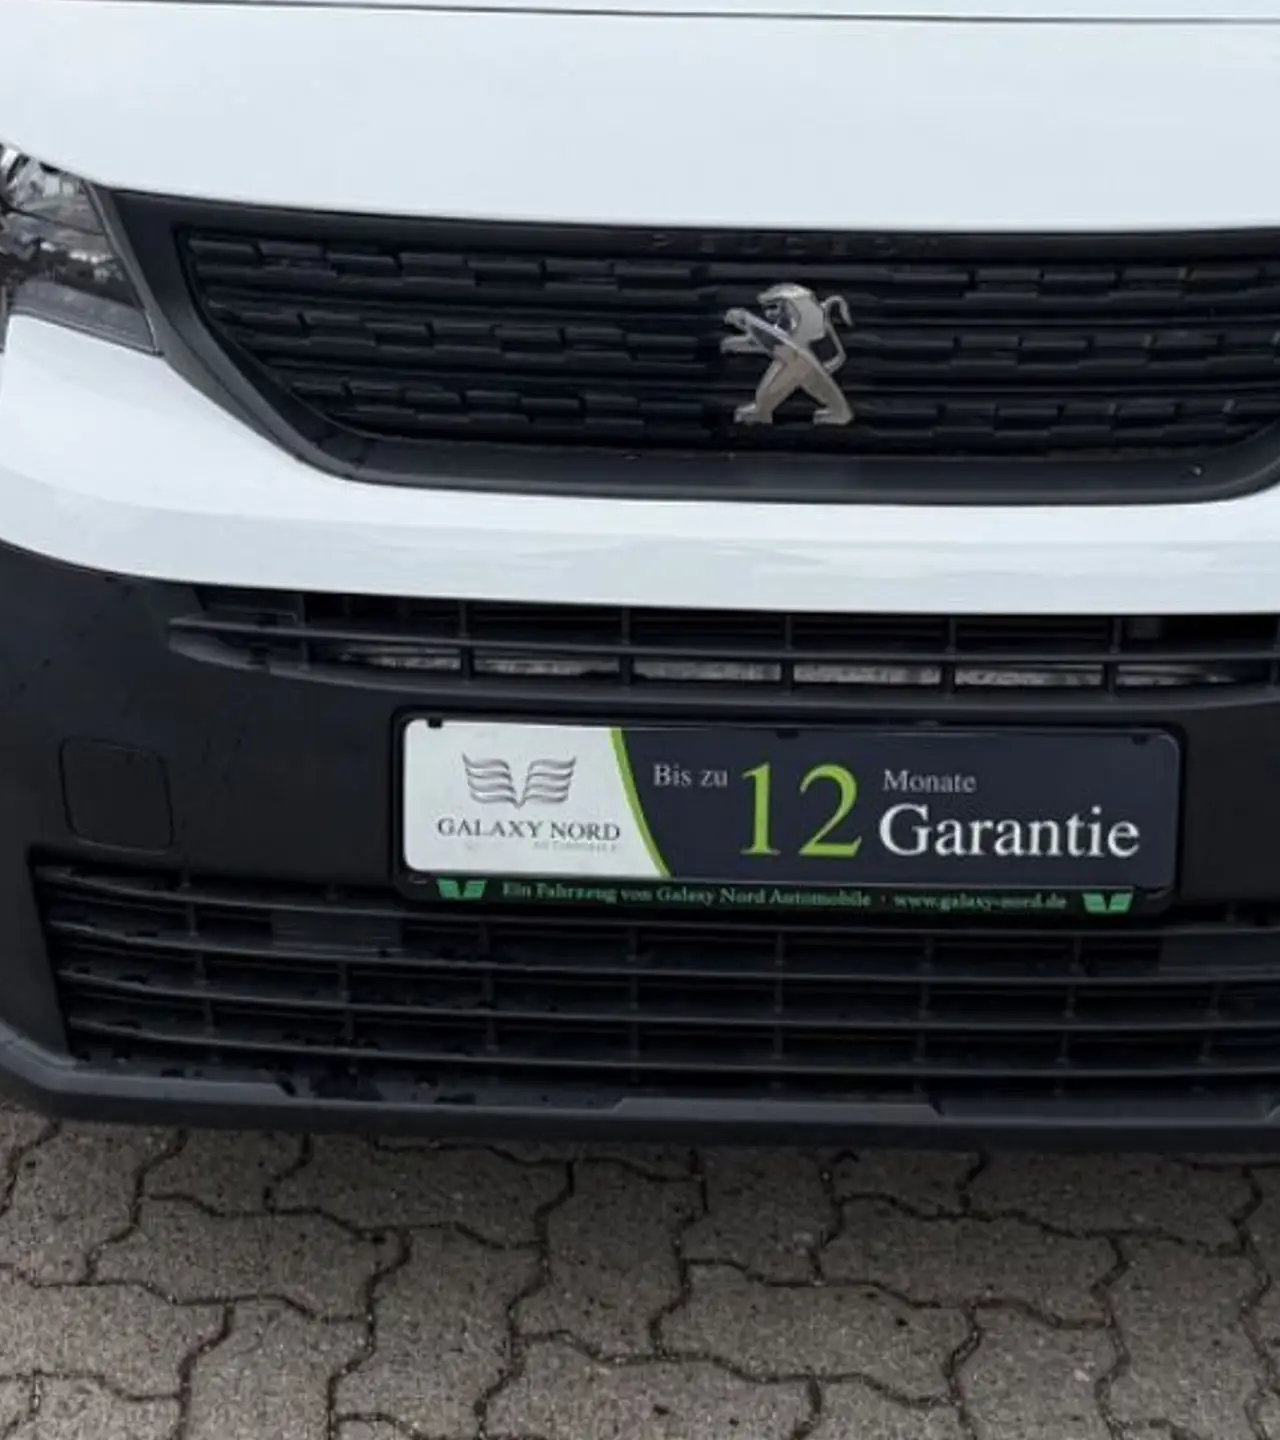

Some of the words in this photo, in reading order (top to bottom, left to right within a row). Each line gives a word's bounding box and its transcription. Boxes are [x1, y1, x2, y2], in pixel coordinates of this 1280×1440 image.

[882, 768, 977, 793] Monate
[653, 763, 692, 788] Bis
[700, 769, 728, 788] zu
[740, 761, 863, 857] 12
[436, 817, 544, 839] GALAXY
[550, 821, 621, 842] NORD
[879, 802, 1140, 858] Garantie
[502, 881, 531, 897] Ein
[536, 882, 618, 904] Fahrzeug
[621, 888, 653, 902] von
[720, 887, 766, 904] Nord
